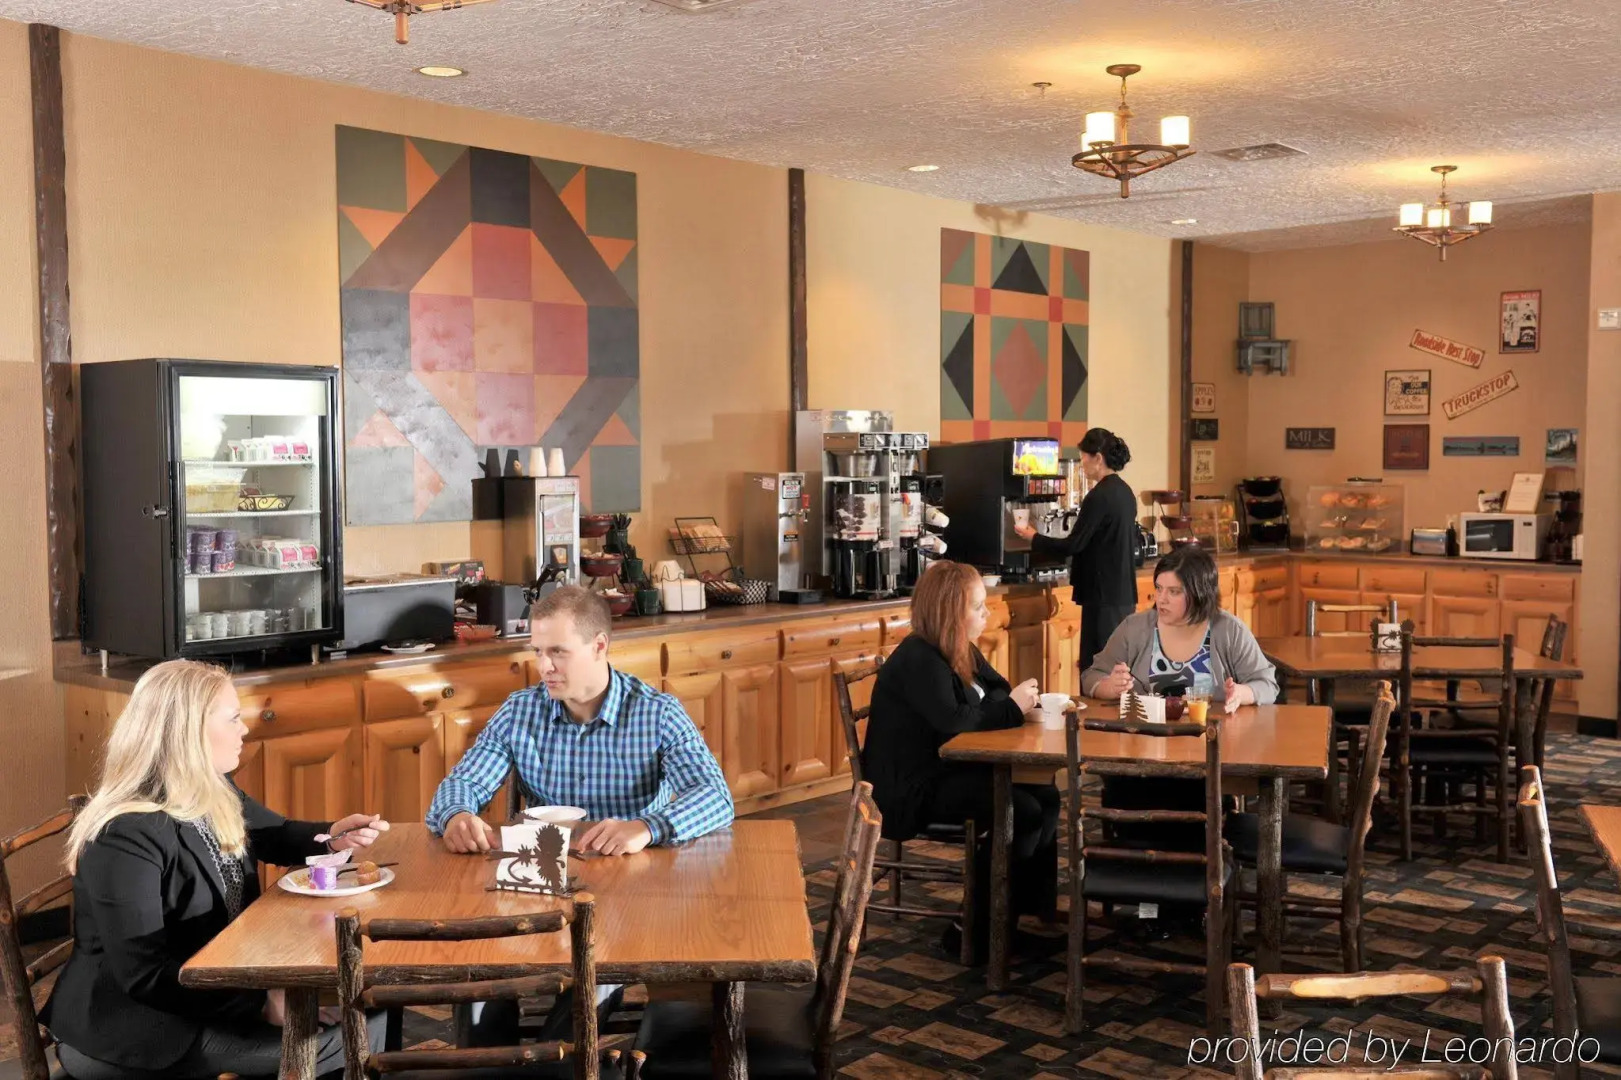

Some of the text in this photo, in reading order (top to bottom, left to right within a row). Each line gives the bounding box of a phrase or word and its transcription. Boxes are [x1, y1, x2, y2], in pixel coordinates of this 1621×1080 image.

[1413, 332, 1446, 354] Roadside
[1462, 347, 1481, 365] Stop
[1447, 374, 1510, 412] TRUCKSTOP
